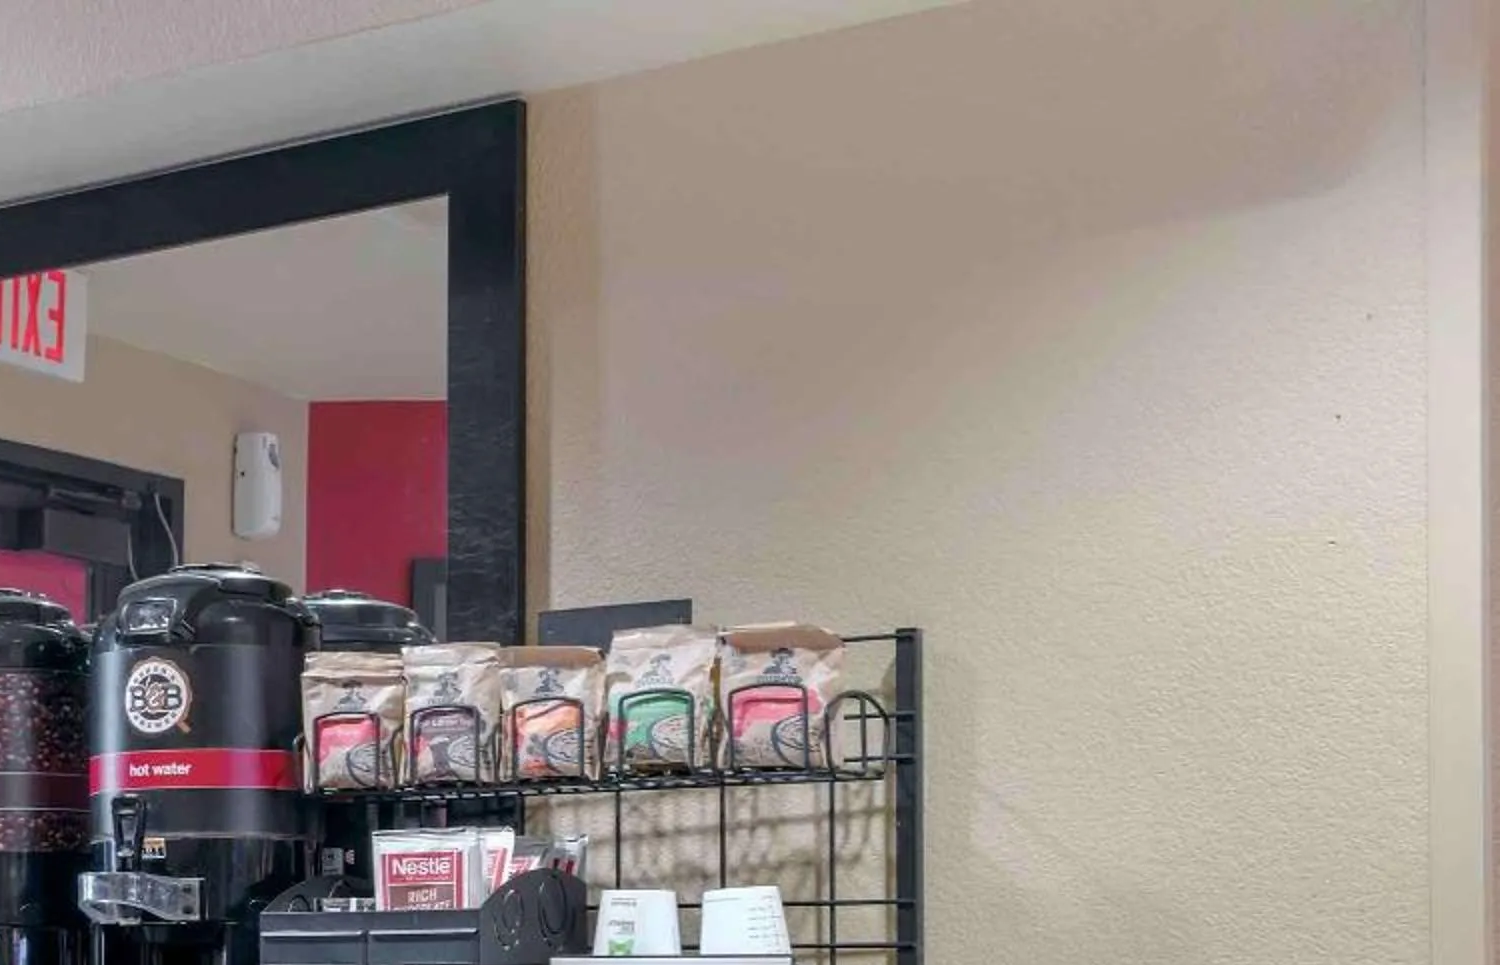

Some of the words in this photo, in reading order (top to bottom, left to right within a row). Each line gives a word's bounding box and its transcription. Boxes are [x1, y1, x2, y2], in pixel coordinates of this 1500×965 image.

[129, 763, 149, 776] hot
[151, 762, 192, 775] water
[407, 887, 437, 903] RICH
